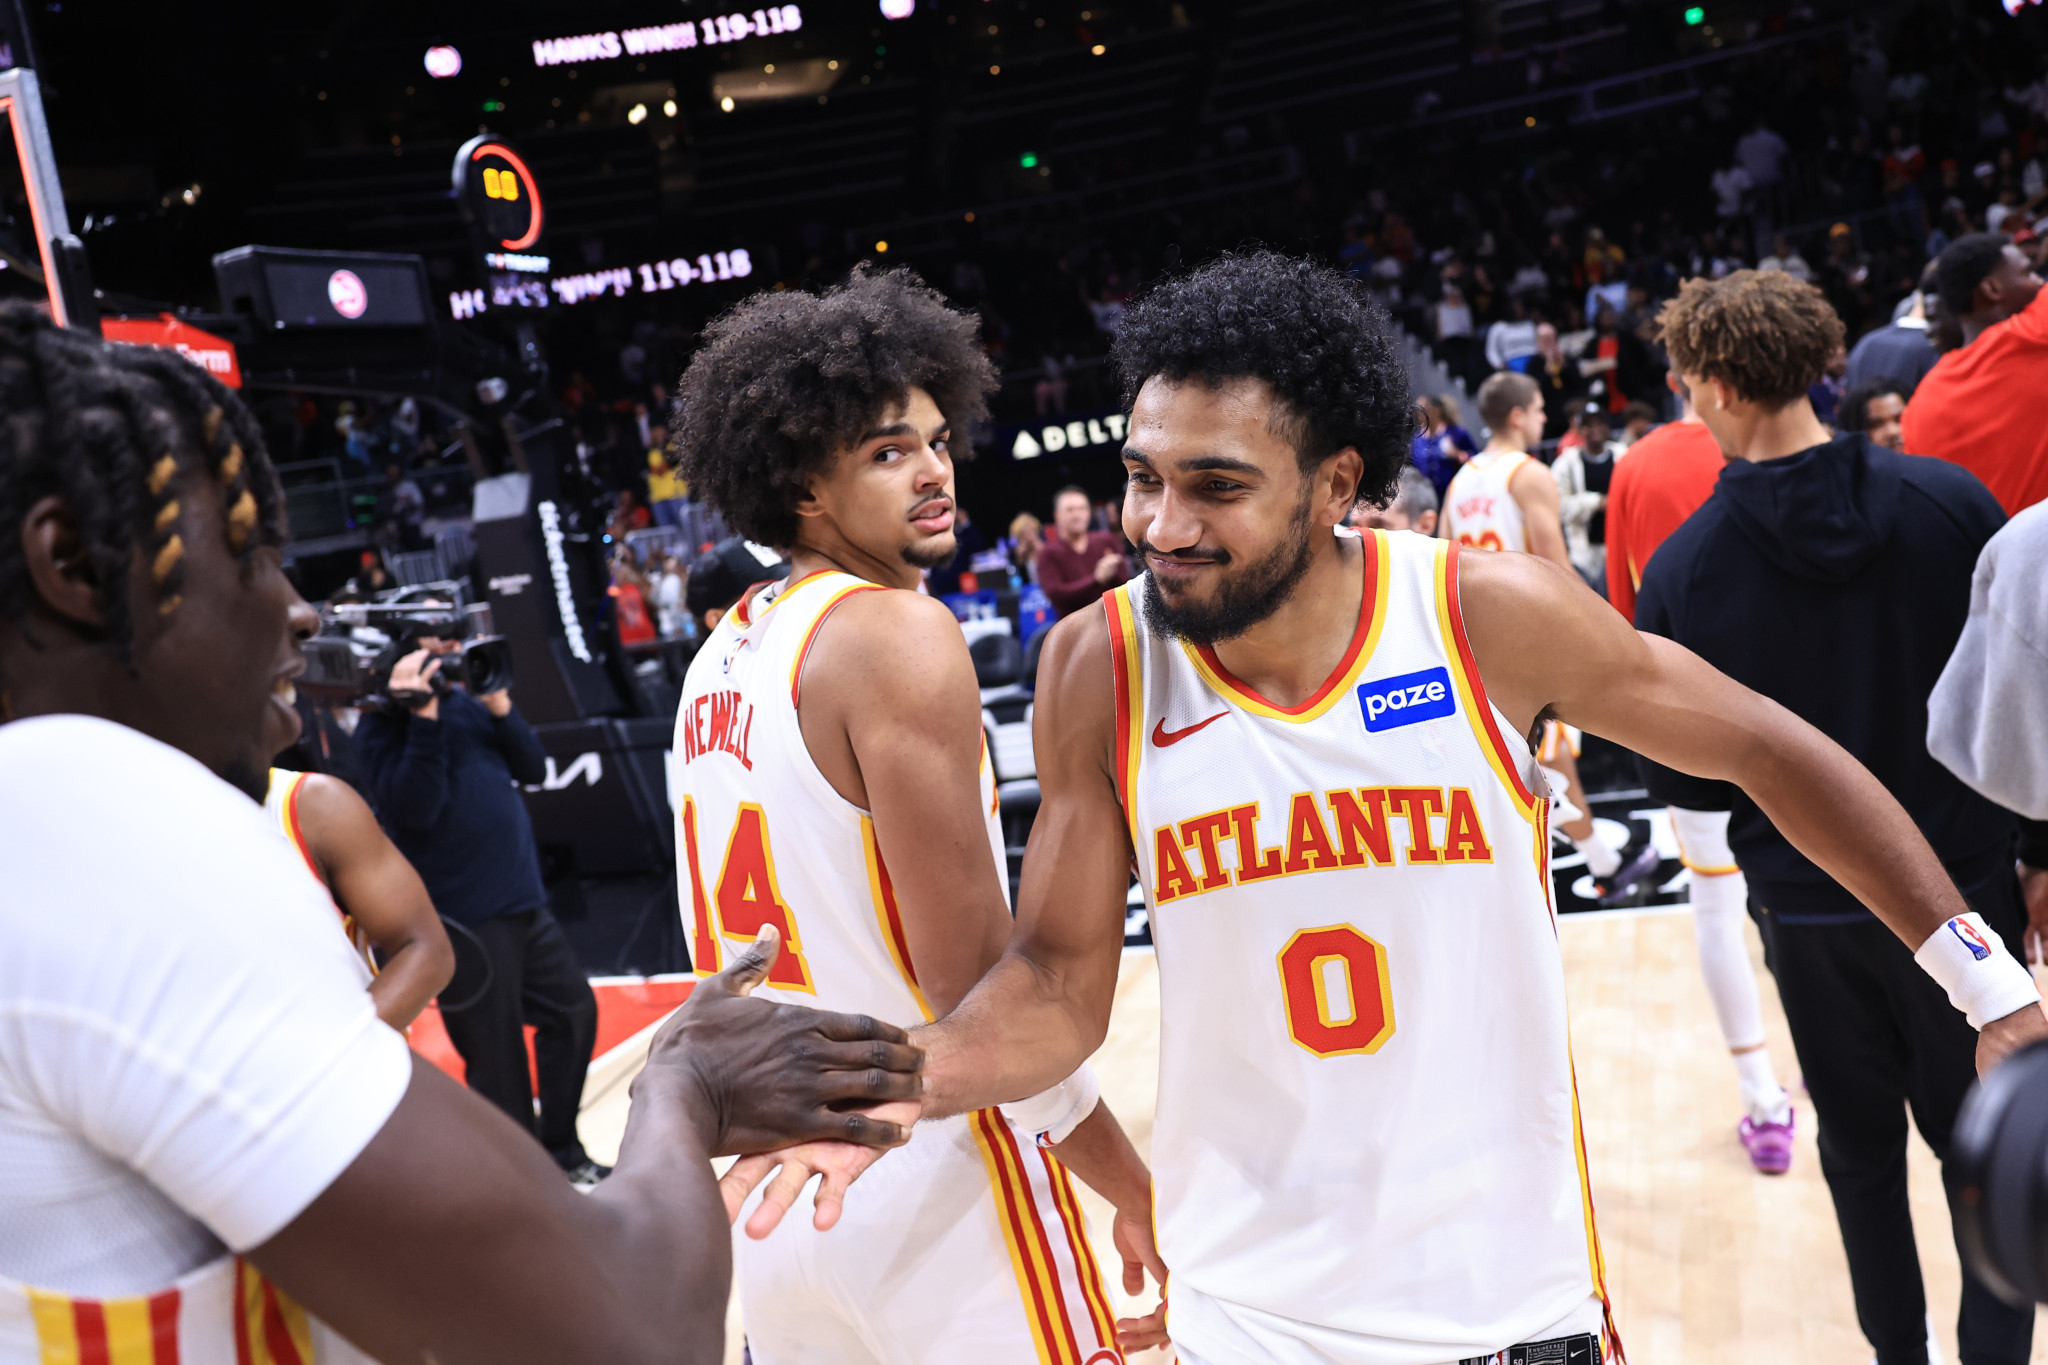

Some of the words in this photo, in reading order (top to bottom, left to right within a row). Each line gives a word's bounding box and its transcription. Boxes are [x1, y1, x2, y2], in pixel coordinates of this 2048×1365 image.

[532, 32, 621, 67] HAWKS
[700, 4, 802, 45] 119-118
[638, 249, 753, 293] 119-118
[1042, 414, 1133, 453] DELT
[685, 689, 754, 772] NEWELL
[1365, 681, 1446, 721] paze
[1154, 785, 1494, 907] ATLANTA
[682, 793, 817, 997] 14
[1276, 922, 1396, 1060] 0
